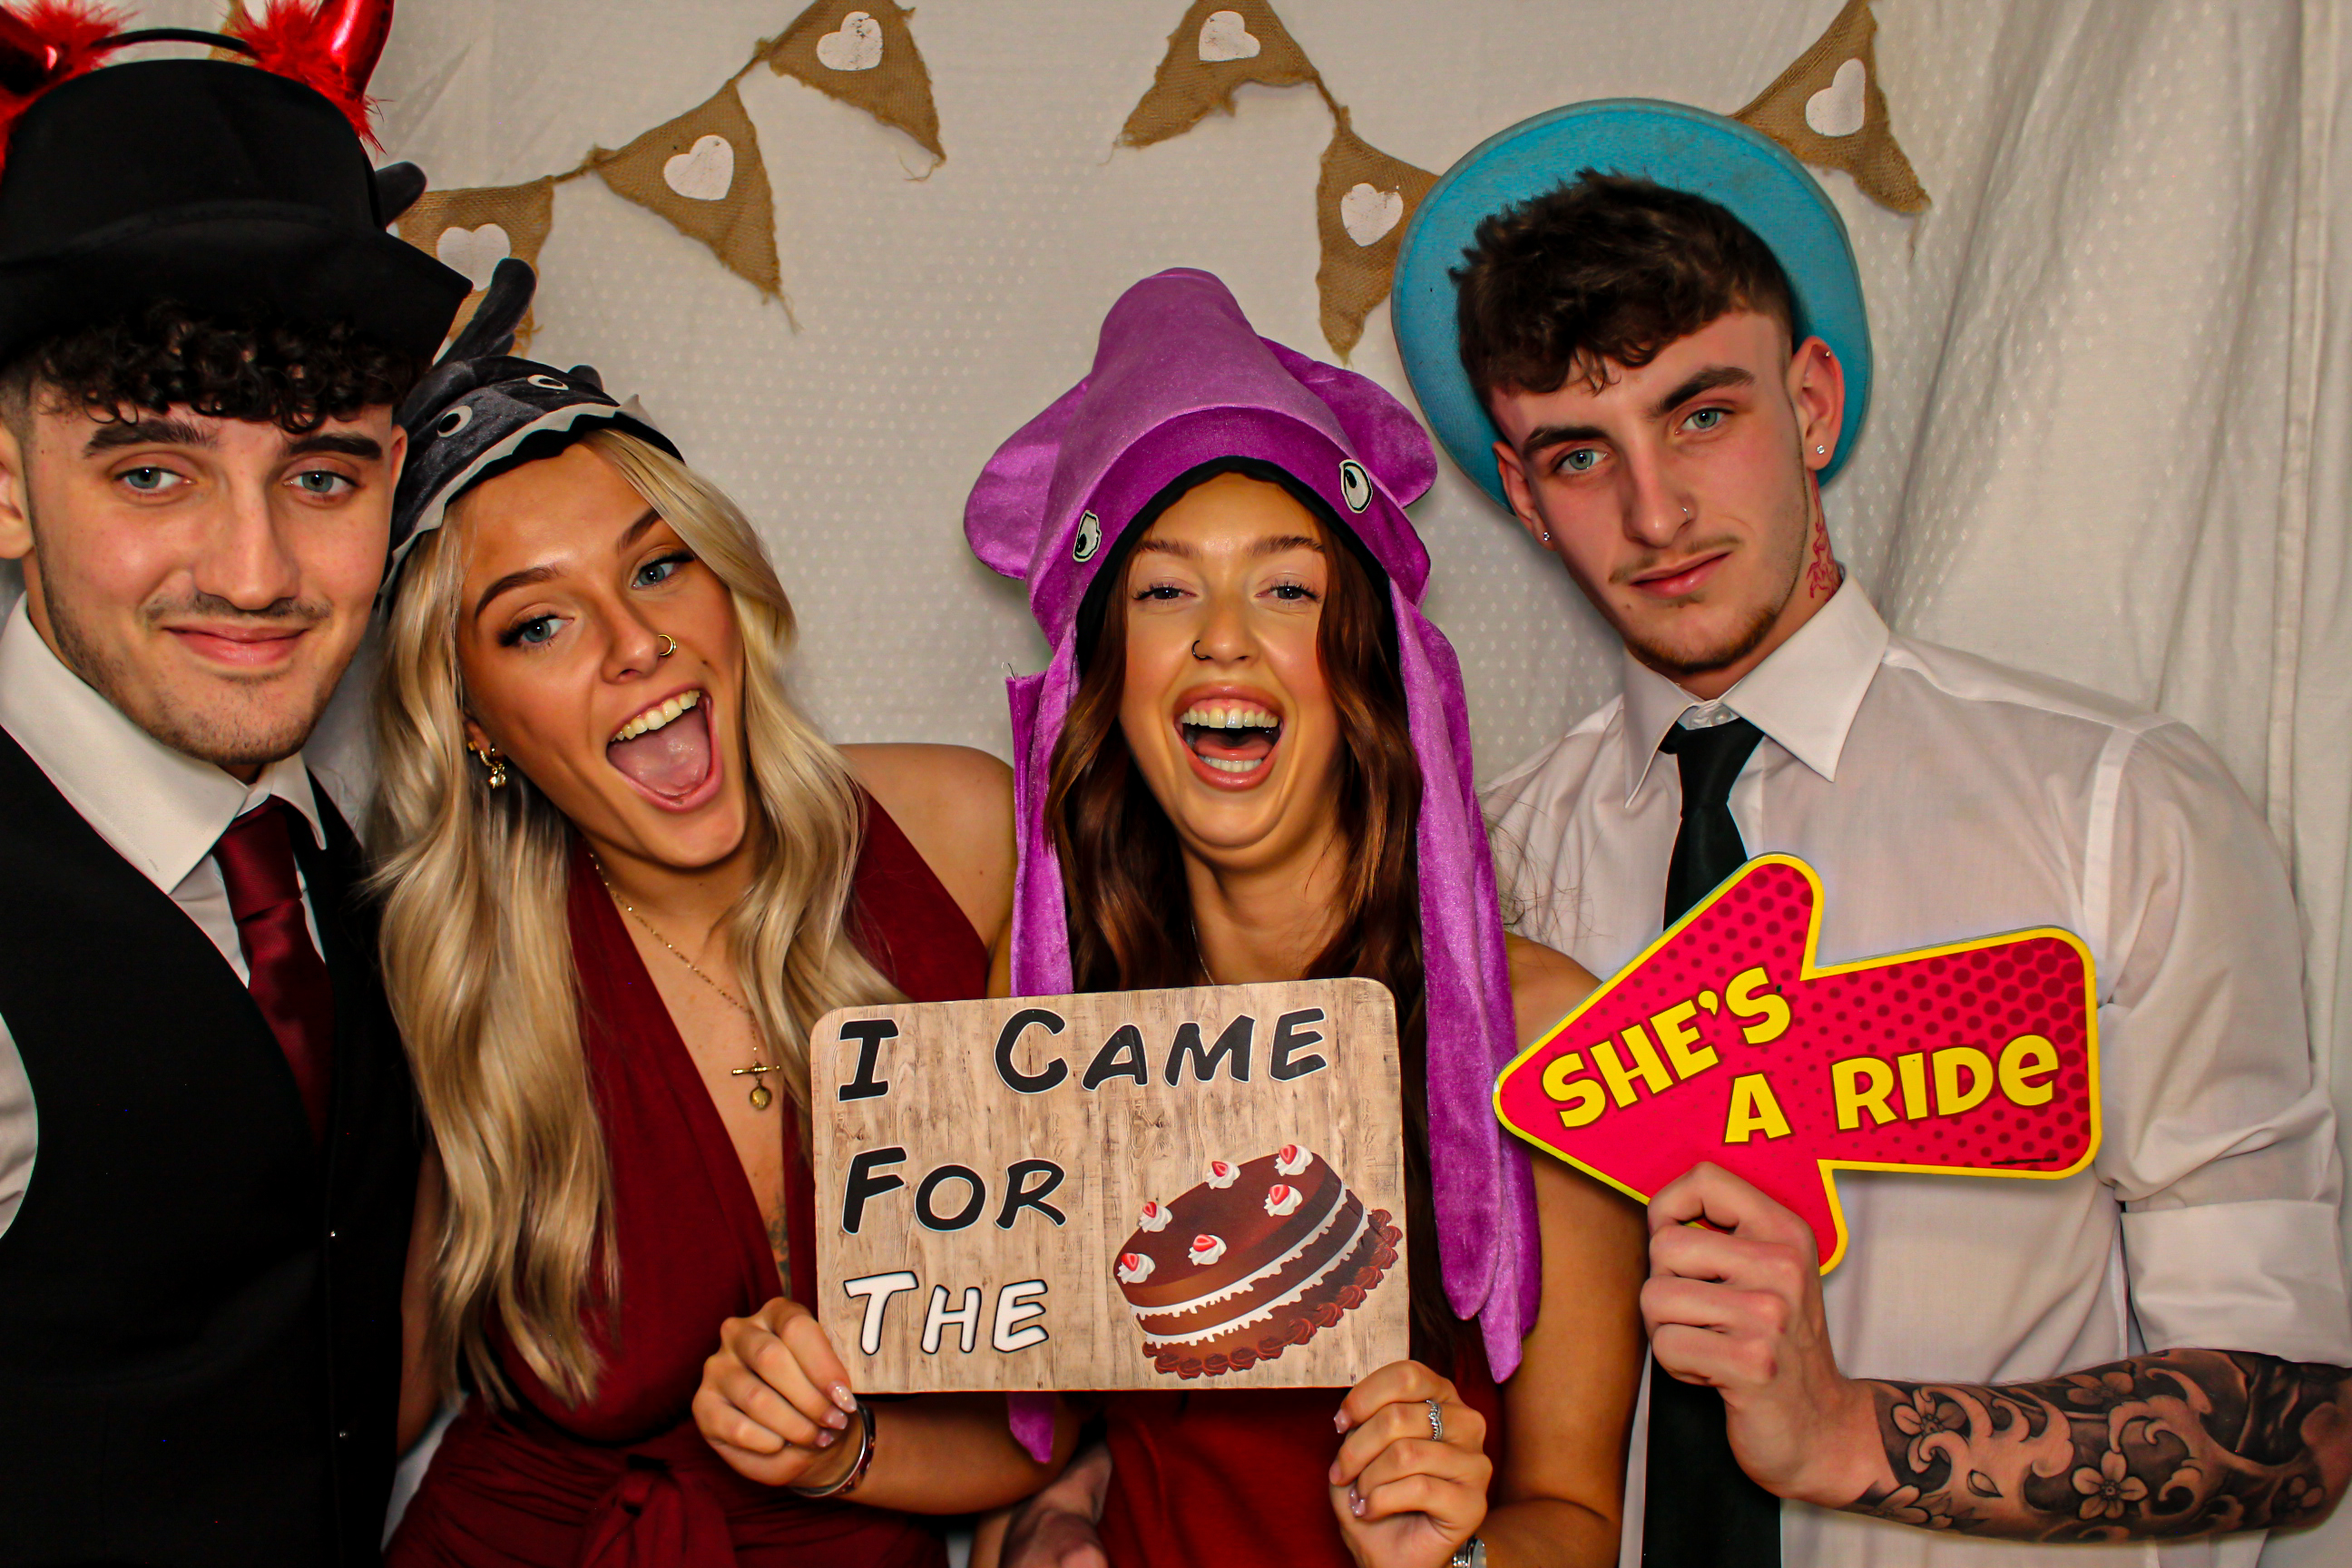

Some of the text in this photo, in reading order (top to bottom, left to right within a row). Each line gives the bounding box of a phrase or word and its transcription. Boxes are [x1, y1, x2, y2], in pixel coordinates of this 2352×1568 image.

[838, 1008, 1328, 1102] I CAME
[1542, 966, 1791, 1128] SHE'S
[1724, 1073, 1792, 1143] A
[841, 1147, 1067, 1234] FOR
[843, 1270, 1048, 1356] THE
